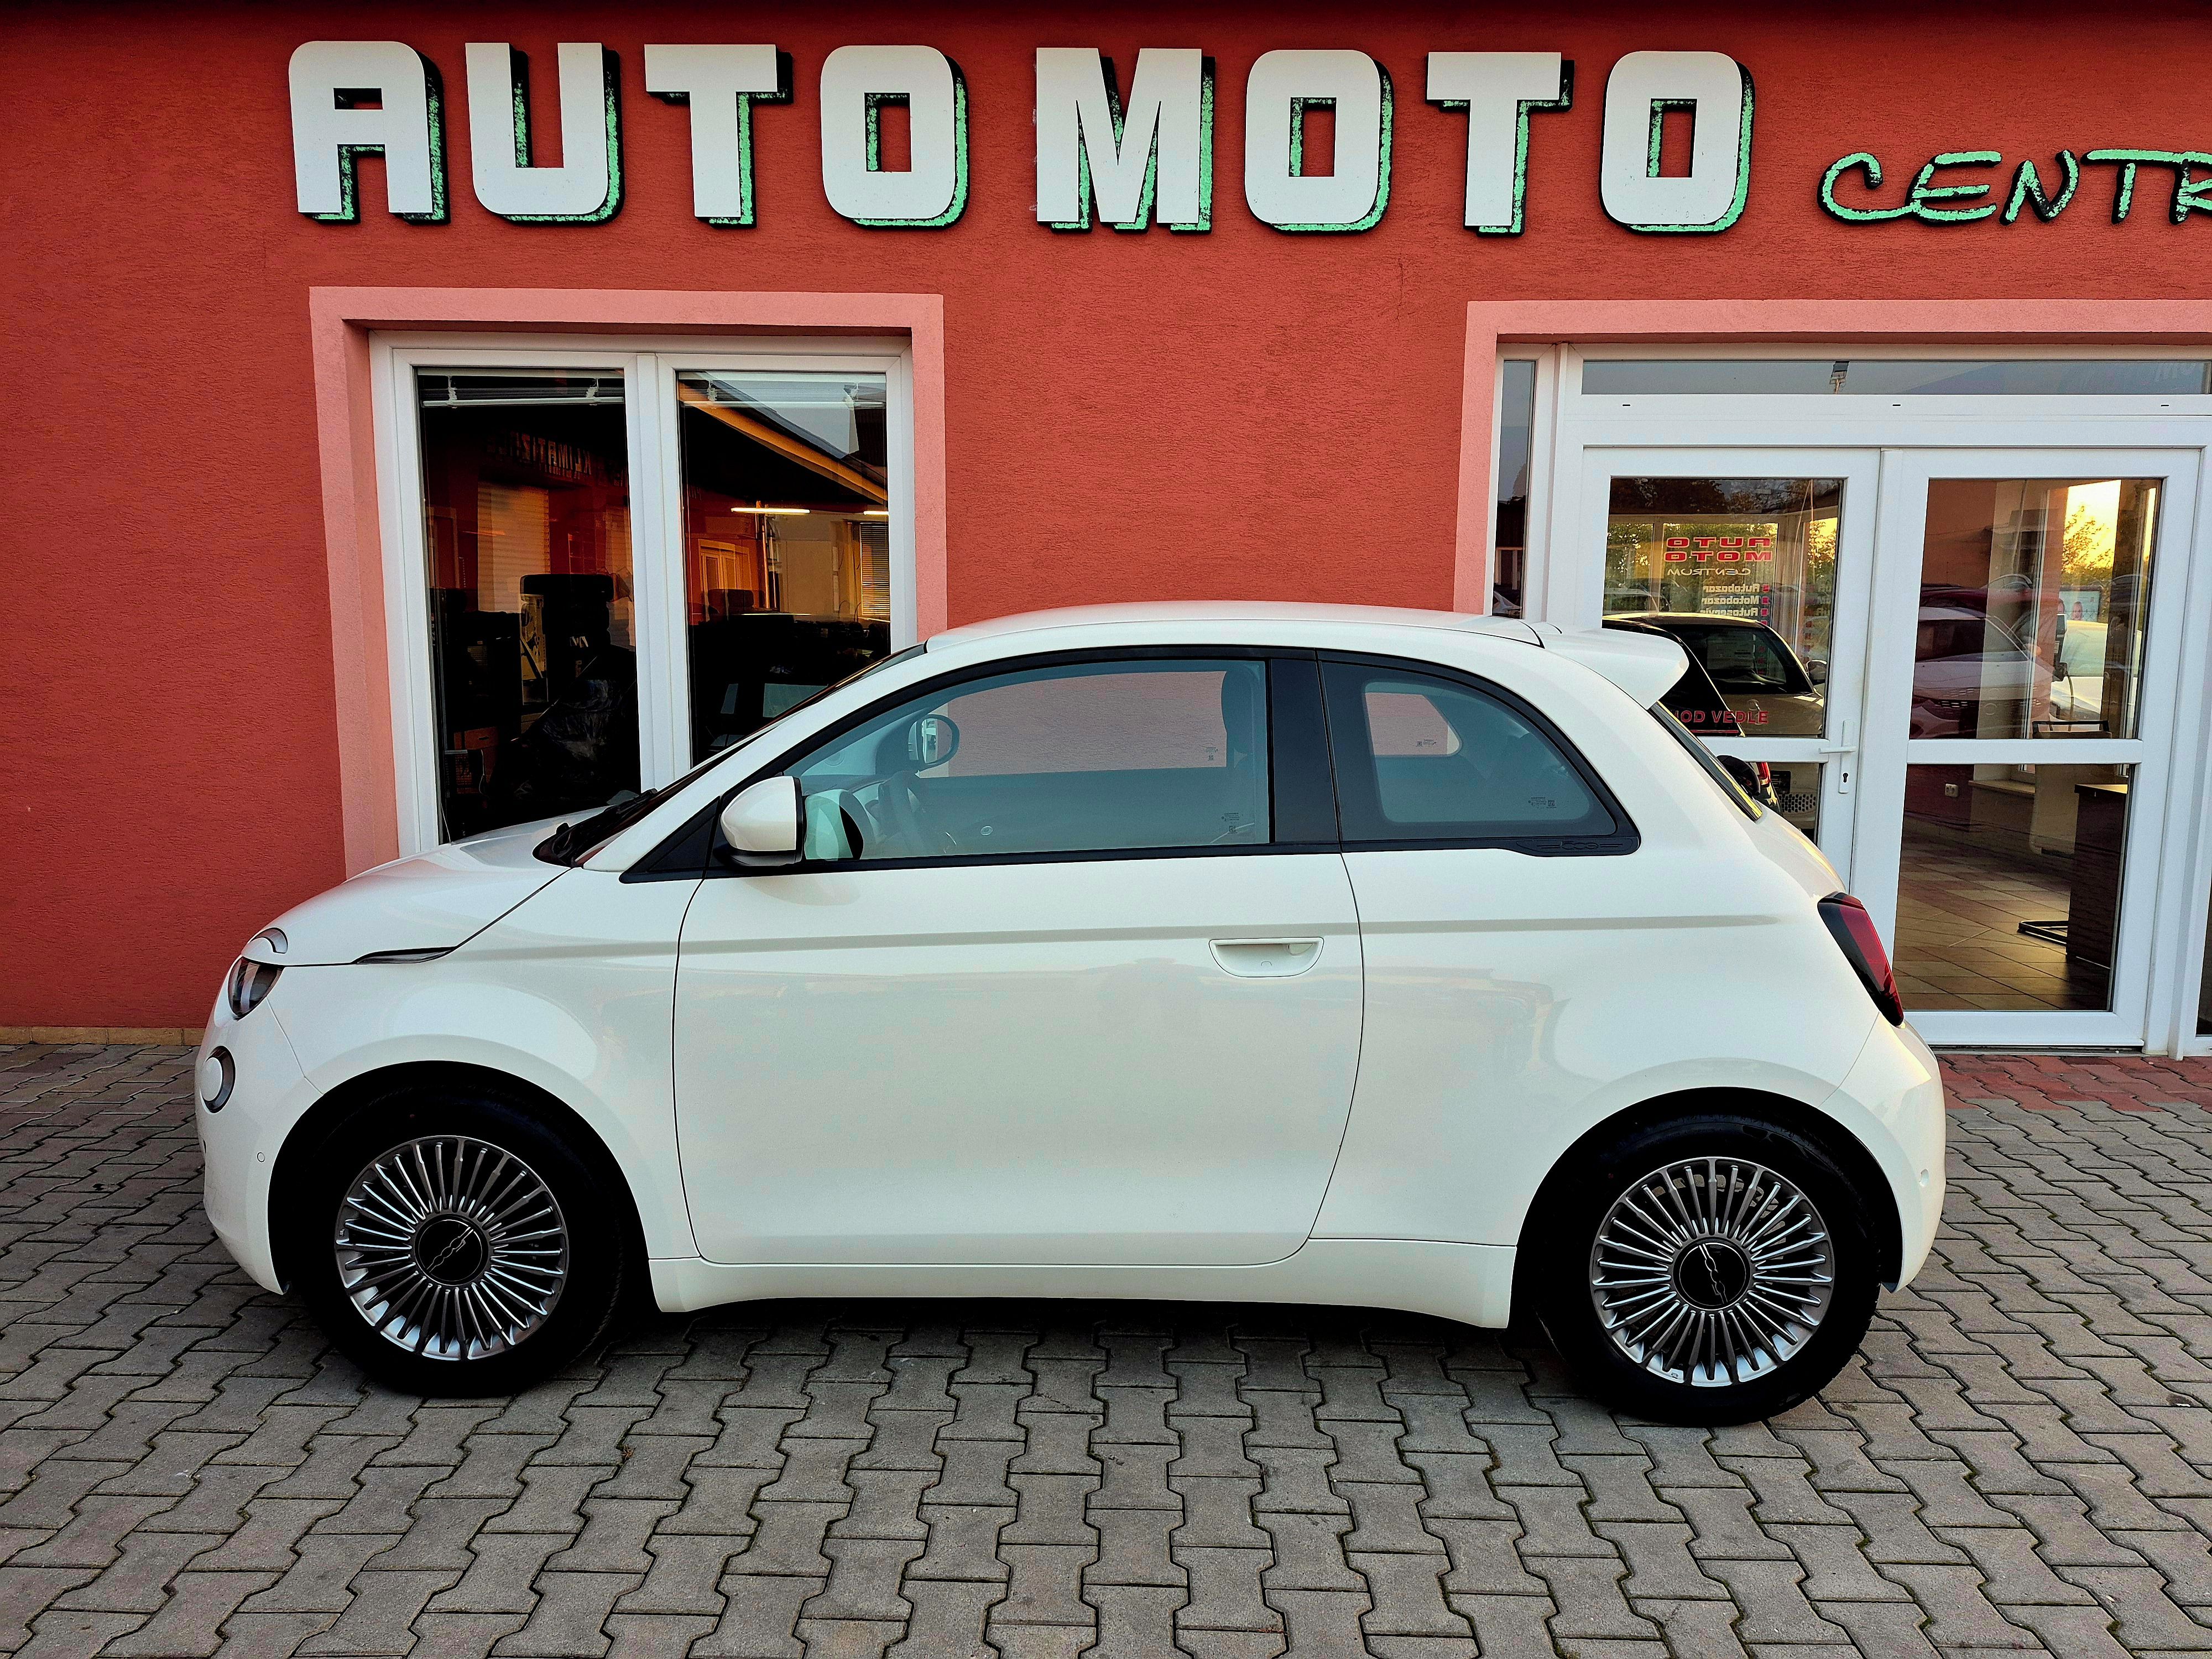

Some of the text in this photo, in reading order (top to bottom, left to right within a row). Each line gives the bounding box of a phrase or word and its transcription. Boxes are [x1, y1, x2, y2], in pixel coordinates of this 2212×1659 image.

[288, 40, 1755, 236] AUTO MOTO
[1817, 149, 2212, 225] CENTR
[1712, 710, 1770, 724] VEDLE
